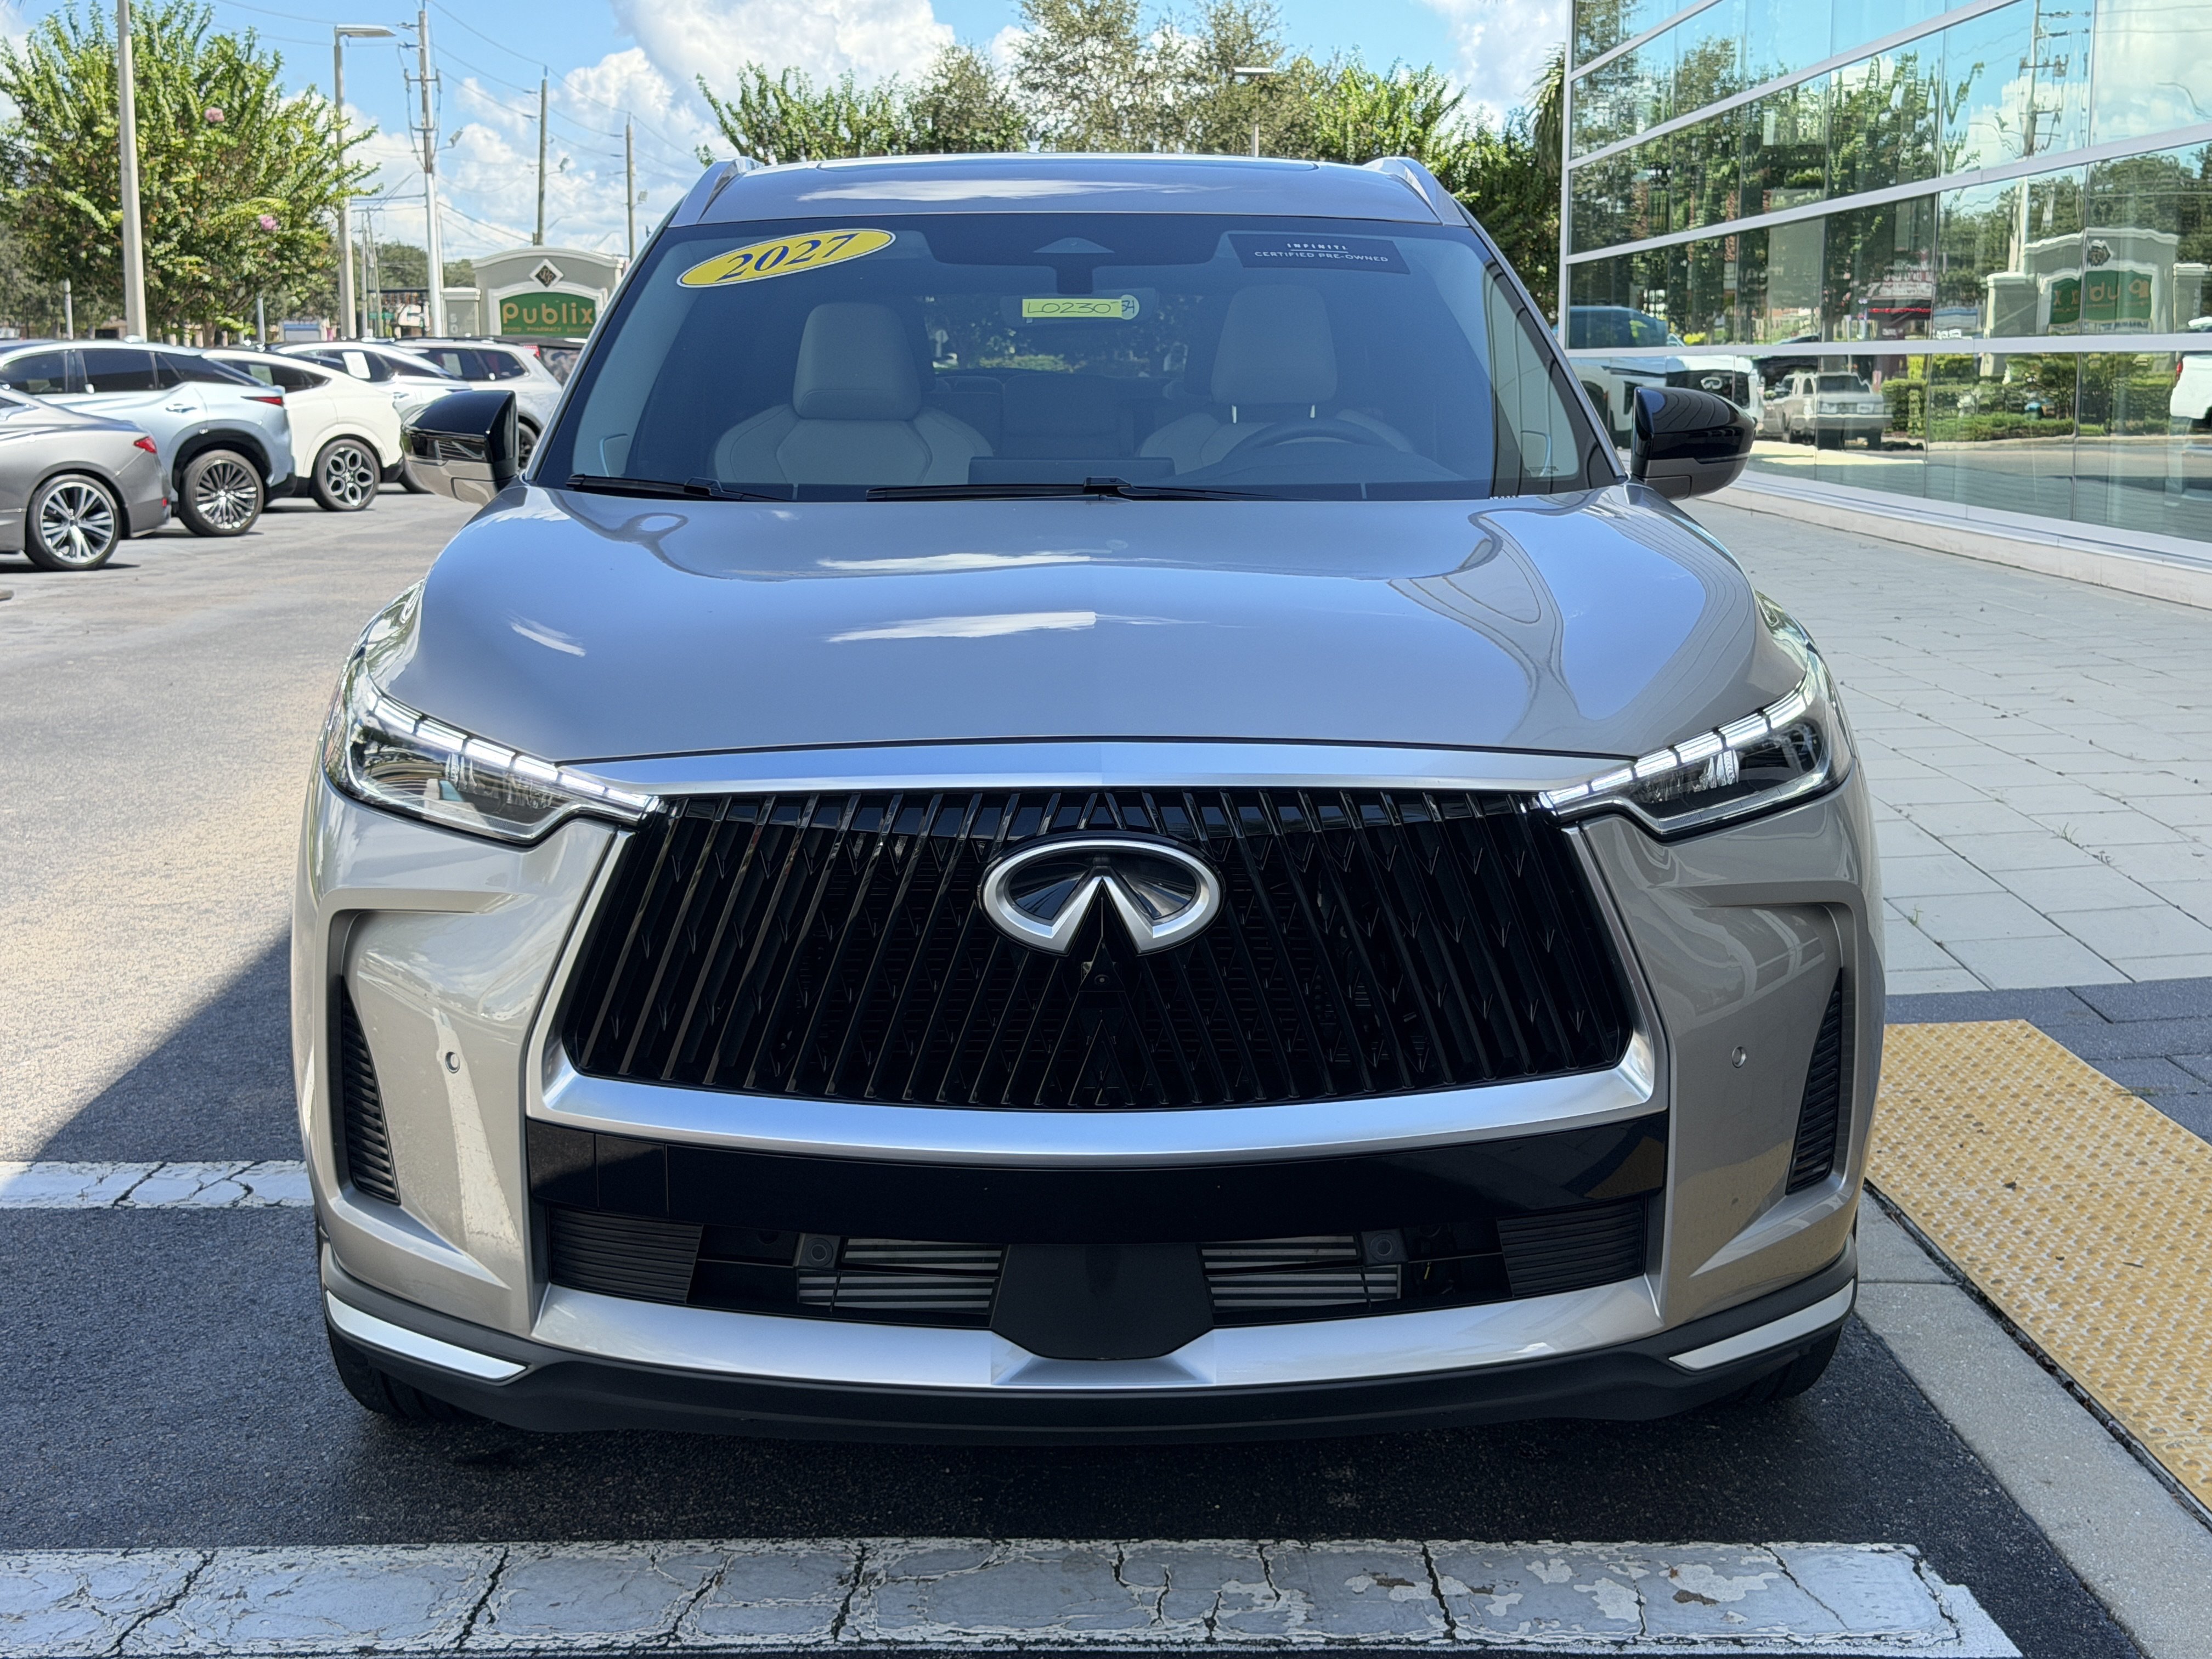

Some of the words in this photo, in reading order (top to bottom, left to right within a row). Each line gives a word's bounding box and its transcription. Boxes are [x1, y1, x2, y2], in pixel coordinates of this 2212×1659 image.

[714, 232, 861, 282] 2027
[1318, 252, 1389, 262] PRE-OWNED
[502, 302, 594, 324] Publix
